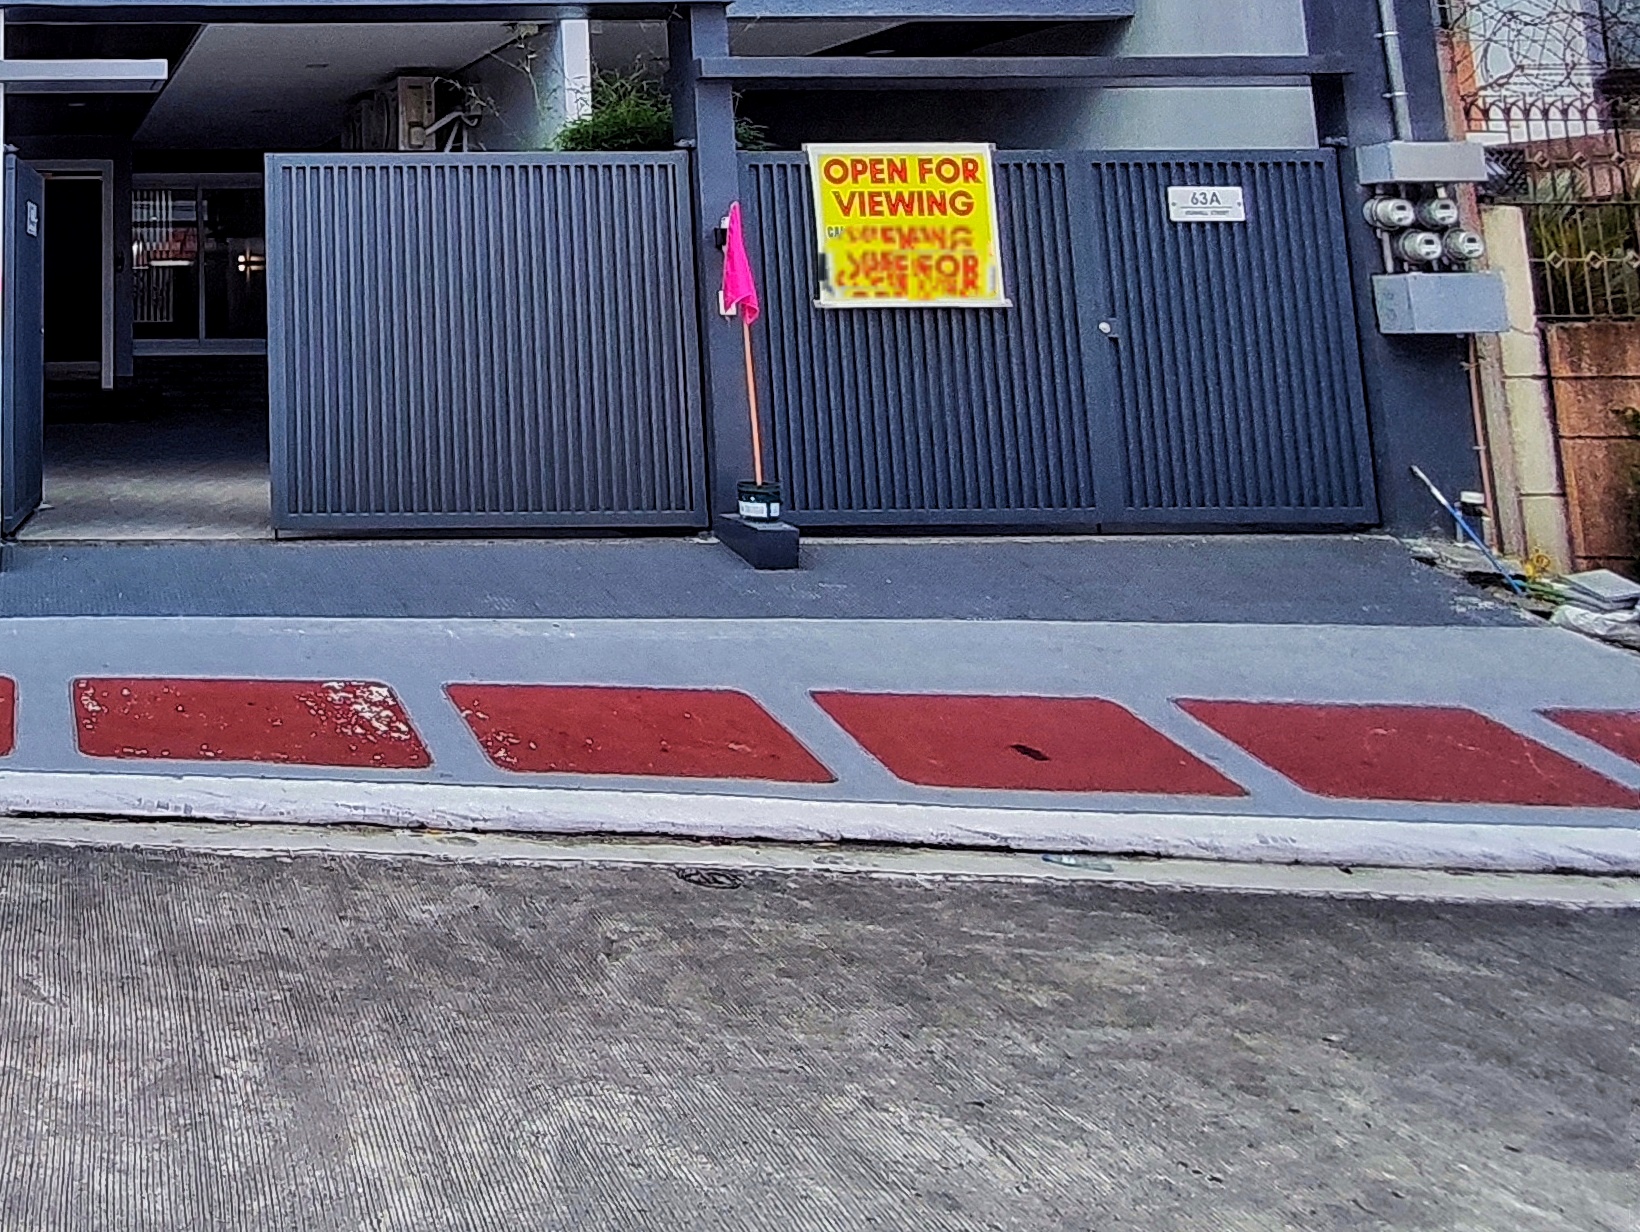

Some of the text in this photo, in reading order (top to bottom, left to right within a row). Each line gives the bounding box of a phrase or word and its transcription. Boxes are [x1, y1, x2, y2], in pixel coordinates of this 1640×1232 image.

[823, 157, 983, 185] OPEN FOR
[831, 189, 975, 217] VIEWING
[1190, 191, 1222, 206] 63A
